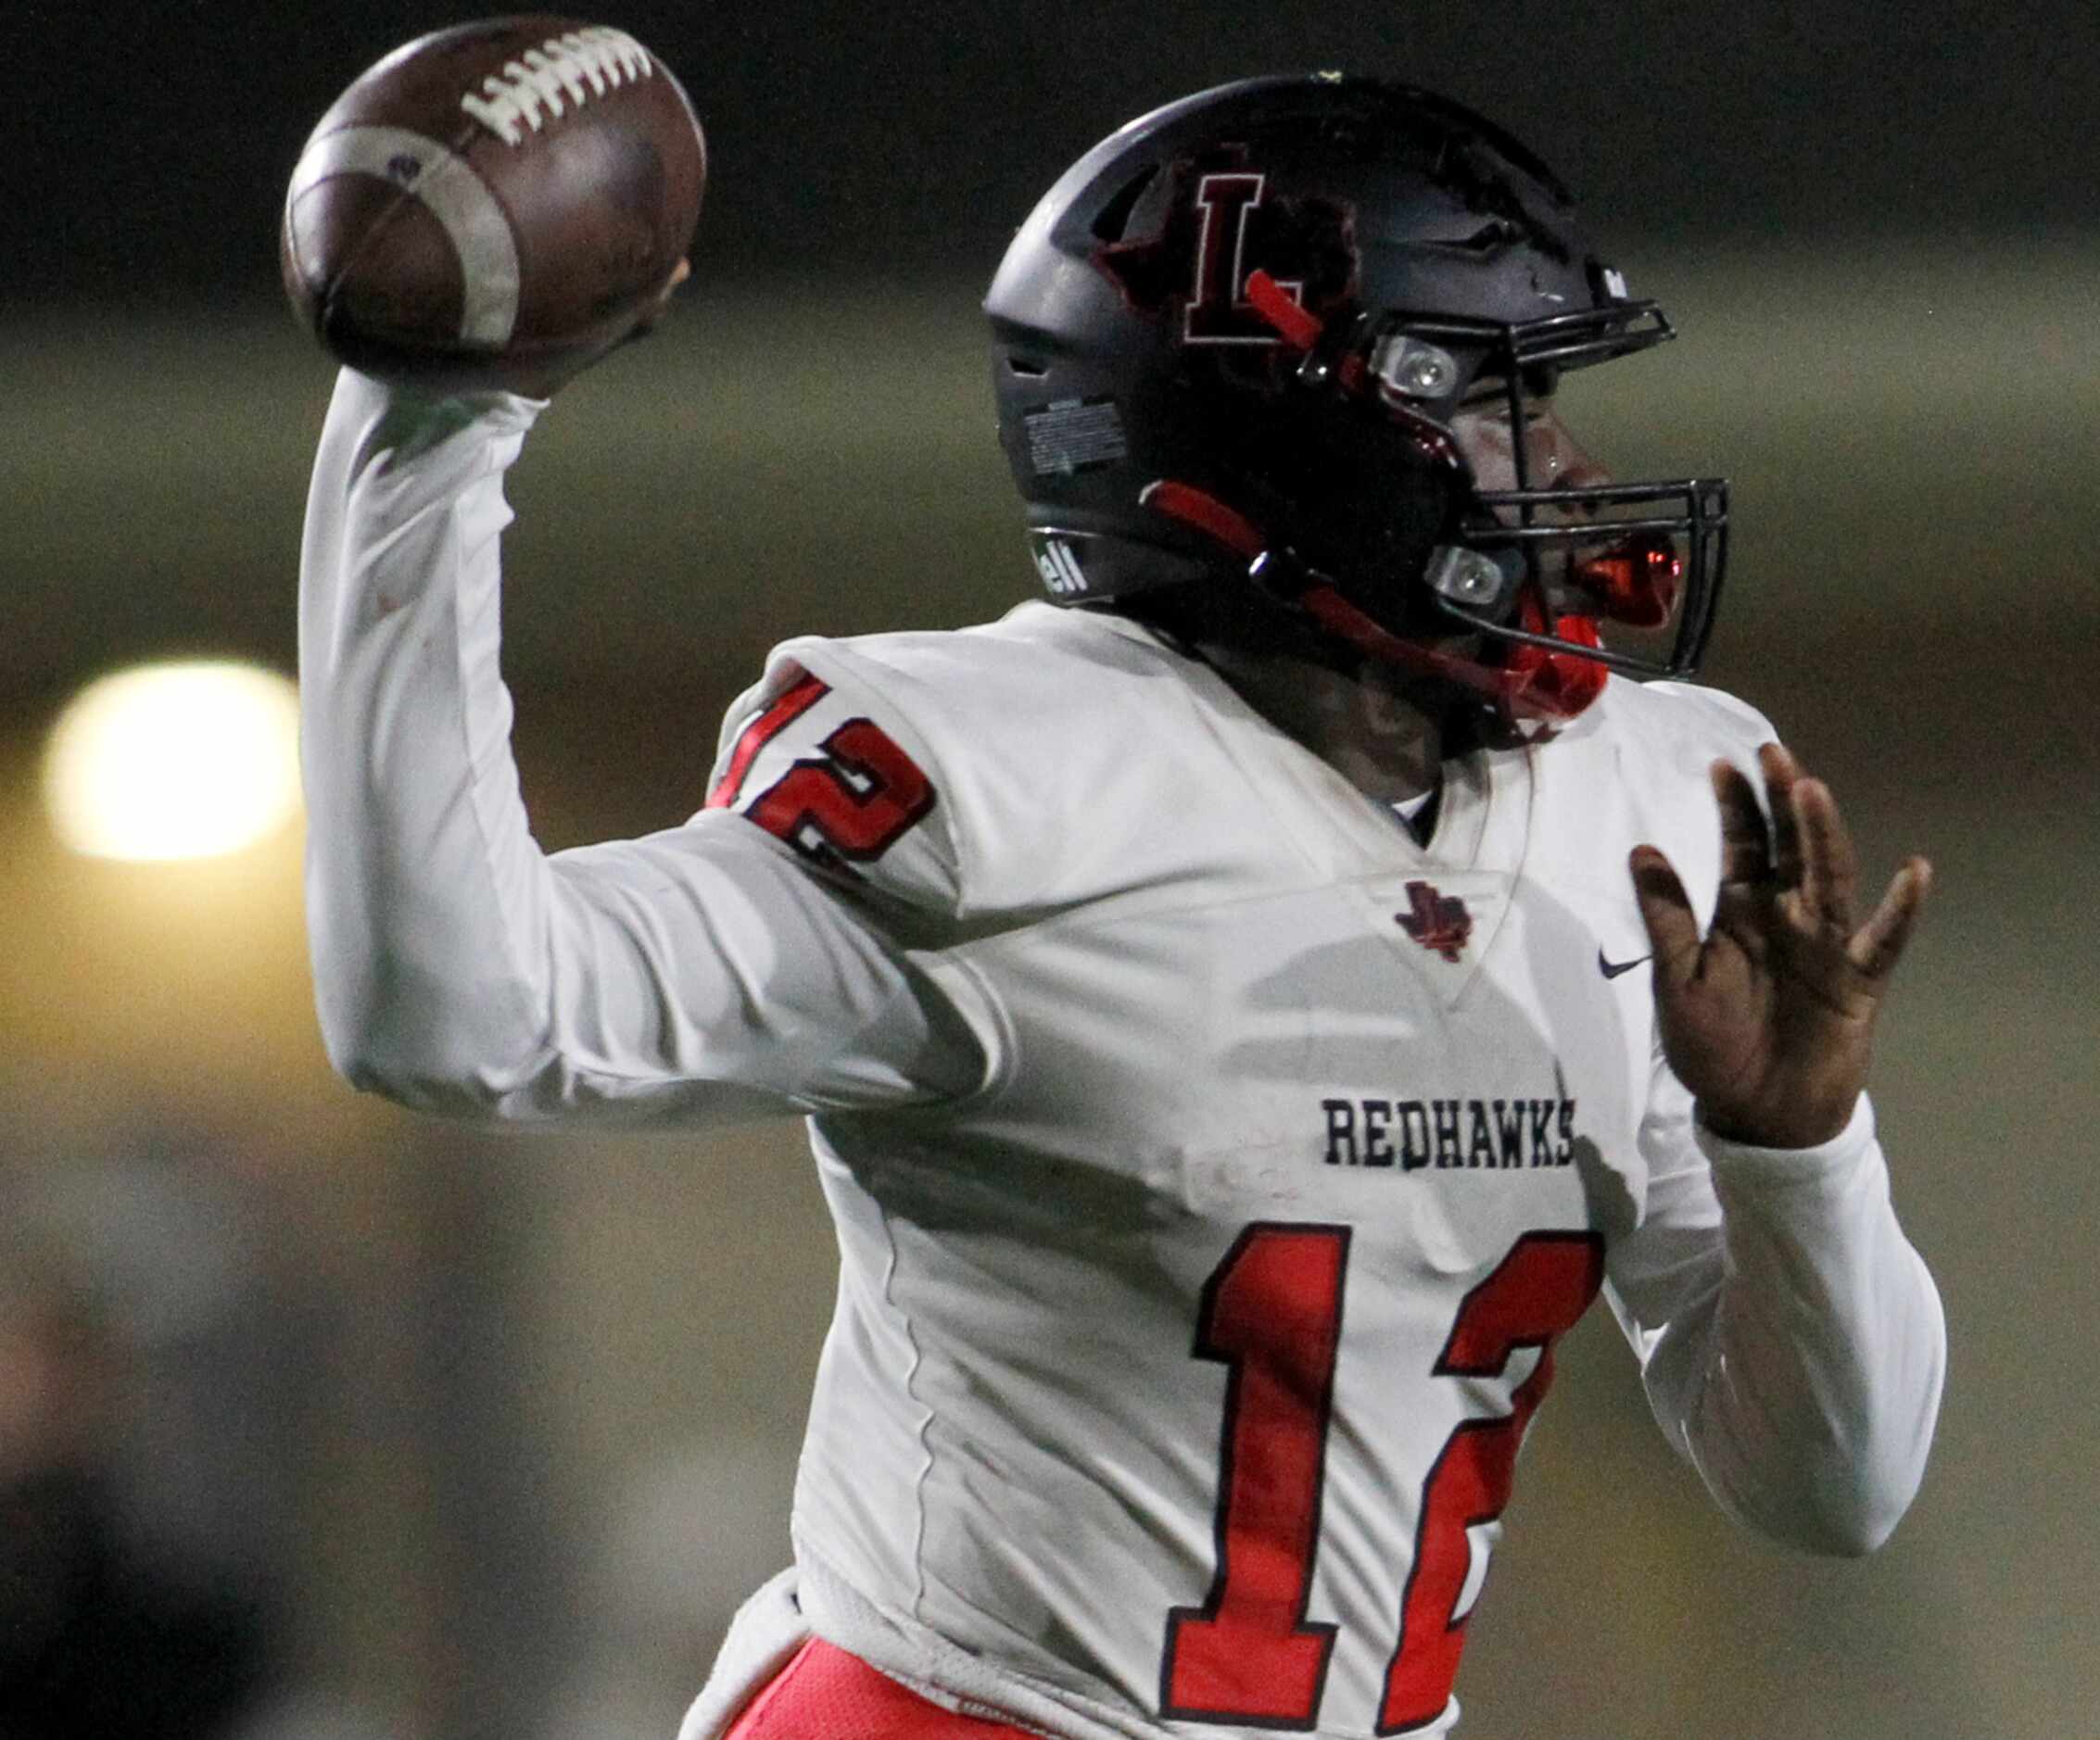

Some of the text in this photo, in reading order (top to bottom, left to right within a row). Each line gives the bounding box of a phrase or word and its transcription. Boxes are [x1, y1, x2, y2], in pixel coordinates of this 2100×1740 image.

[1184, 173, 1303, 344] L
[1030, 539, 1088, 593] ell
[705, 665, 938, 862] 12
[1322, 1099, 1577, 1170] REDHAWKS
[1159, 1221, 1606, 1738] 12
